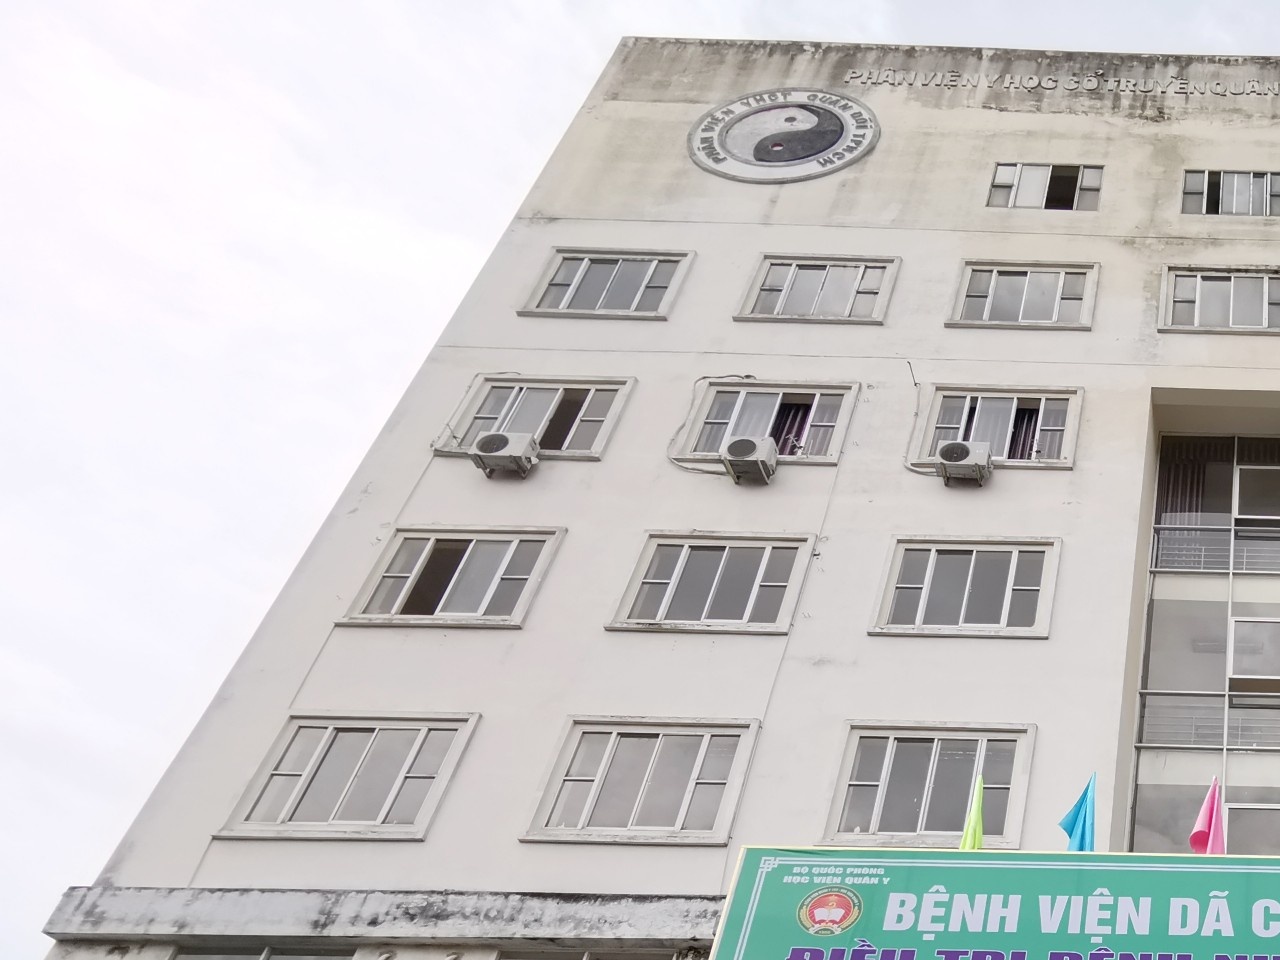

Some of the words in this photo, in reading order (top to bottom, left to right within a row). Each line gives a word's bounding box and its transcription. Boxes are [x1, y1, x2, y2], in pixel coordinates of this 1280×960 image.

[844, 67, 916, 87] PHÂN
[917, 70, 981, 90] VIỆN
[983, 74, 1001, 88] Y
[1003, 74, 1058, 92] HỌC
[1062, 69, 1105, 91] CỔ
[1104, 75, 1208, 96] TRUYỀN
[1209, 79, 1279, 97] QUÂN
[740, 91, 793, 109] YHCT
[882, 877, 891, 885] Y
[882, 885, 1022, 941] BỆNH
[1038, 888, 1152, 944] VIỆN
[1168, 890, 1235, 937] DÃ
